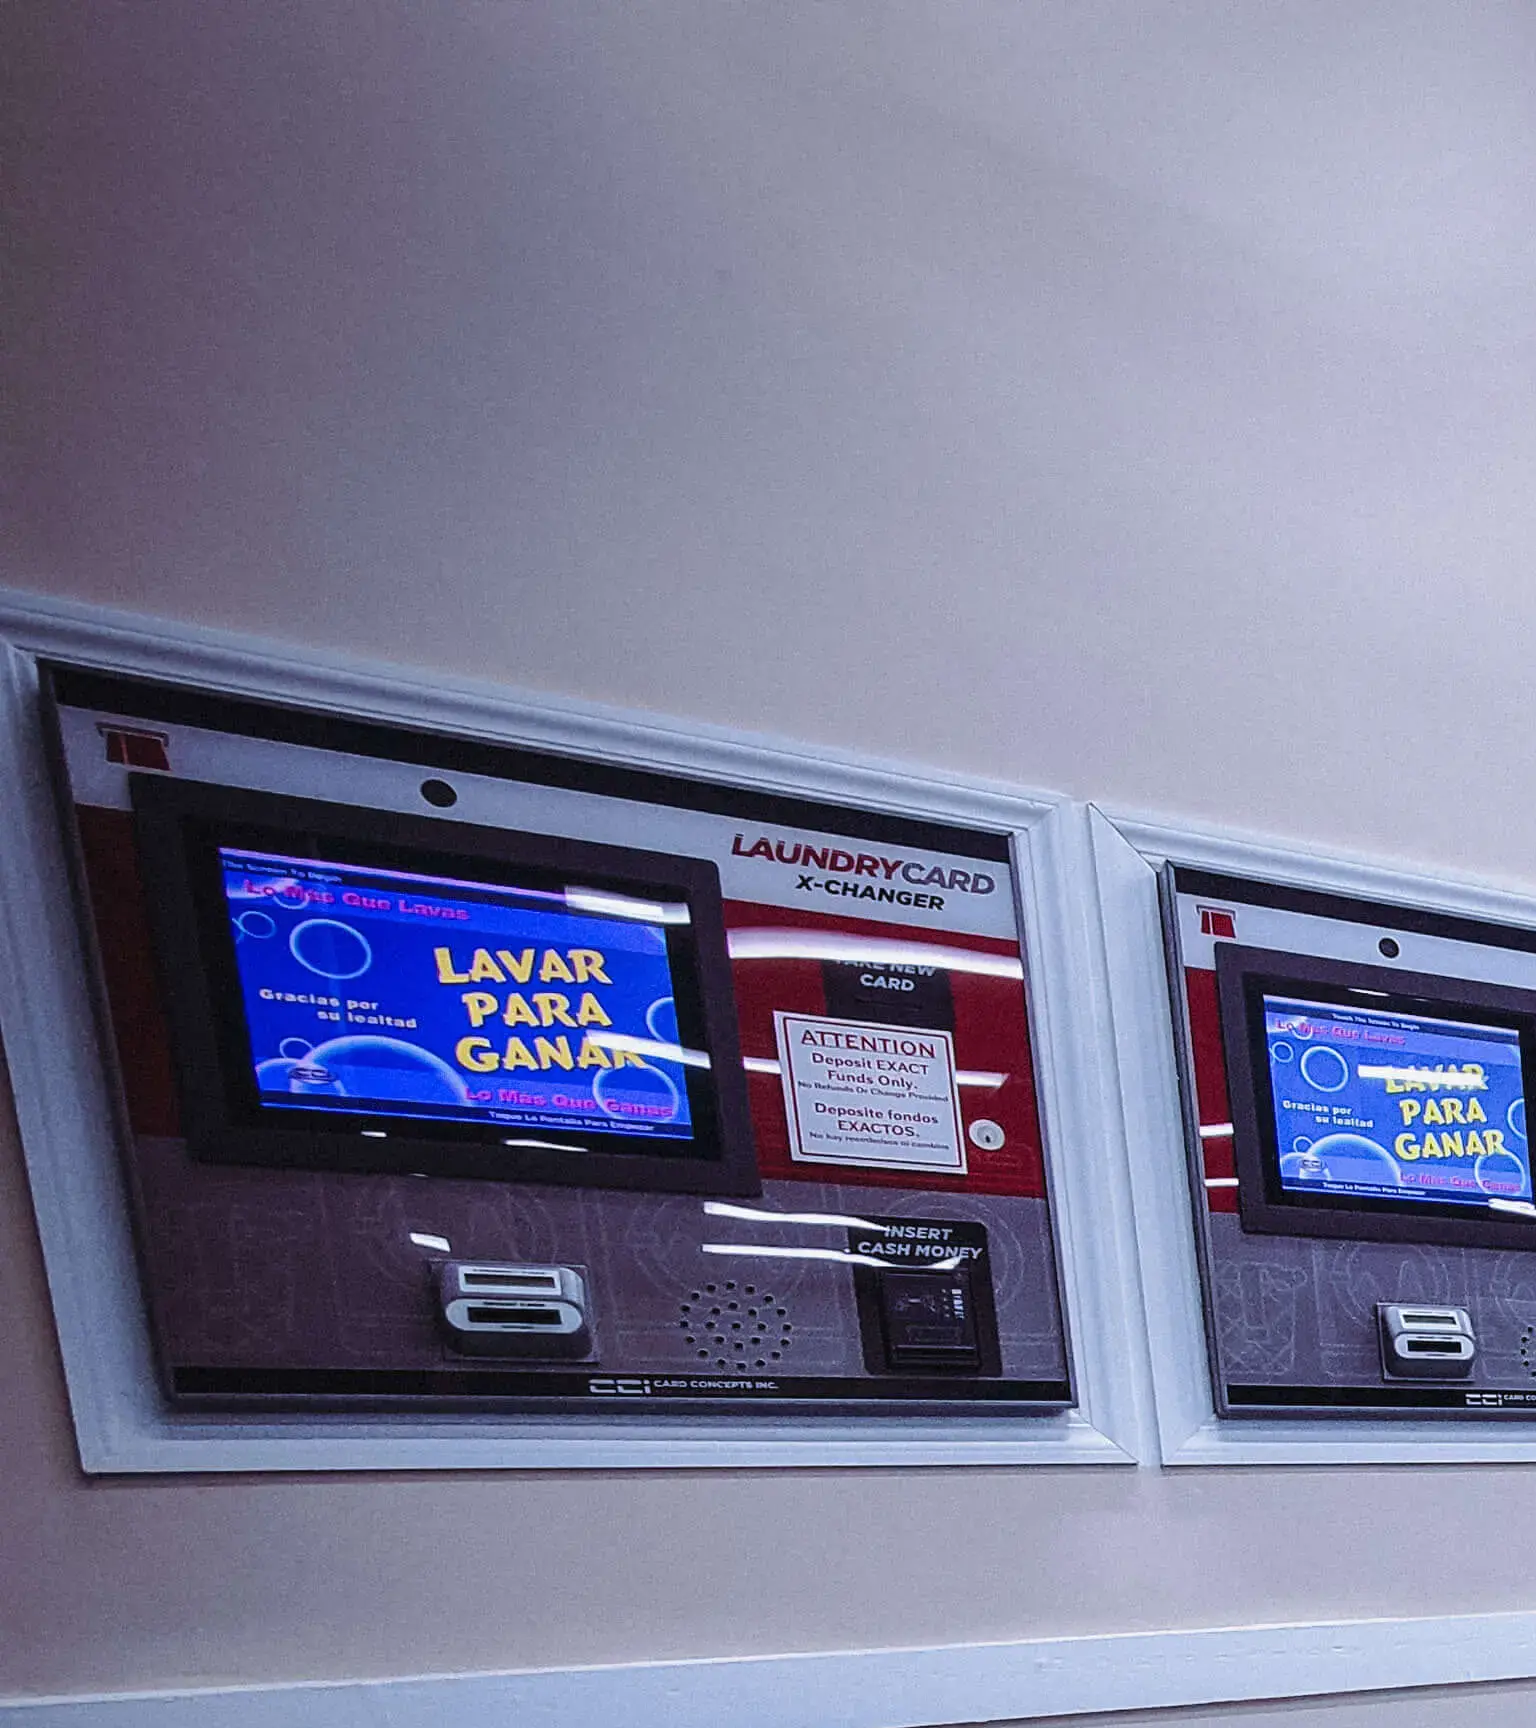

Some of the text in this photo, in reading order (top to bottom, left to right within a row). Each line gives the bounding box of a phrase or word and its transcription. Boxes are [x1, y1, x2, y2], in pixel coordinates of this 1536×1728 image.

[731, 833, 996, 895] LAUNDRYCARD
[796, 874, 945, 911] X-CHANGER
[434, 946, 614, 985] LAVAR
[889, 962, 937, 978] NEW
[859, 973, 915, 993] CARD
[259, 988, 380, 1011] Gracias por
[461, 992, 613, 1029] PARA
[317, 1009, 417, 1029] su lealtad
[801, 1029, 936, 1060] ATTENTION
[812, 1052, 929, 1075] Deposit EXACT
[827, 1070, 919, 1091] Funds Only.
[814, 1102, 939, 1125] Deposite fondos
[1283, 1100, 1353, 1116] Gracias por
[1399, 1097, 1488, 1126] PARA
[837, 1120, 921, 1139] EXACTOS.
[1394, 1128, 1509, 1161] GANAR
[884, 1226, 953, 1241] INSERT
[858, 1241, 984, 1261] CASH MONEY
[690, 1380, 754, 1390] CONCEPTS
